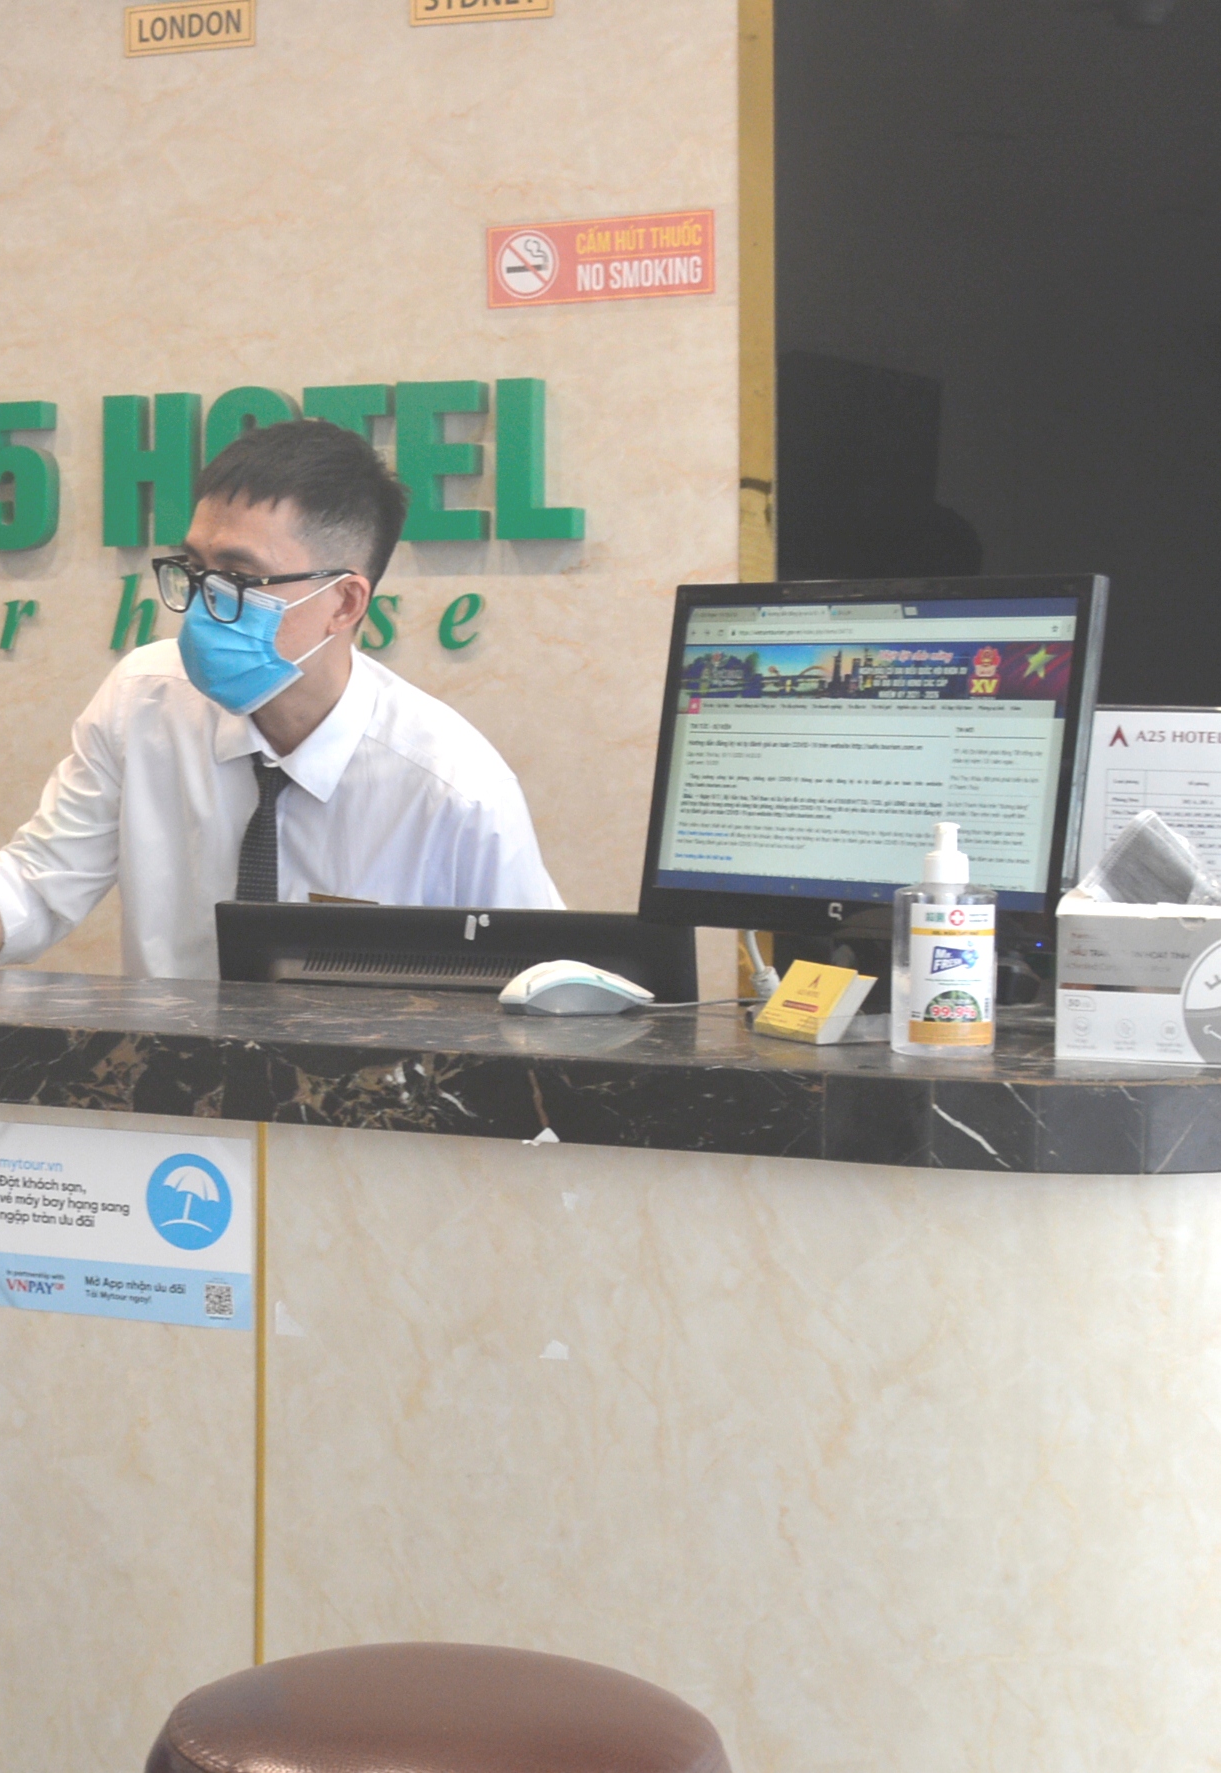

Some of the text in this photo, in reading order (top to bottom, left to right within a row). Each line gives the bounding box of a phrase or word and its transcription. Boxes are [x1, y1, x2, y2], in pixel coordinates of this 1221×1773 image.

[138, 8, 241, 43] LONDON
[575, 218, 703, 255] CẤM HÚT THUỐC
[576, 255, 703, 292] NO SMOKING
[110, 572, 486, 652] hse
[970, 679, 998, 694] XV
[1135, 730, 1166, 743] A25
[931, 1005, 977, 1018] 99.9%
[22, 1177, 59, 1191] khách
[61, 1182, 87, 1196] sạn,
[15, 1193, 39, 1209] máy
[42, 1195, 65, 1211] bay
[67, 1197, 98, 1214] hạng
[100, 1202, 130, 1217] sang
[0, 1209, 95, 1228] ngập tràn ưu đãi
[6, 1278, 54, 1295] VNPAY
[103, 1278, 124, 1290] App
